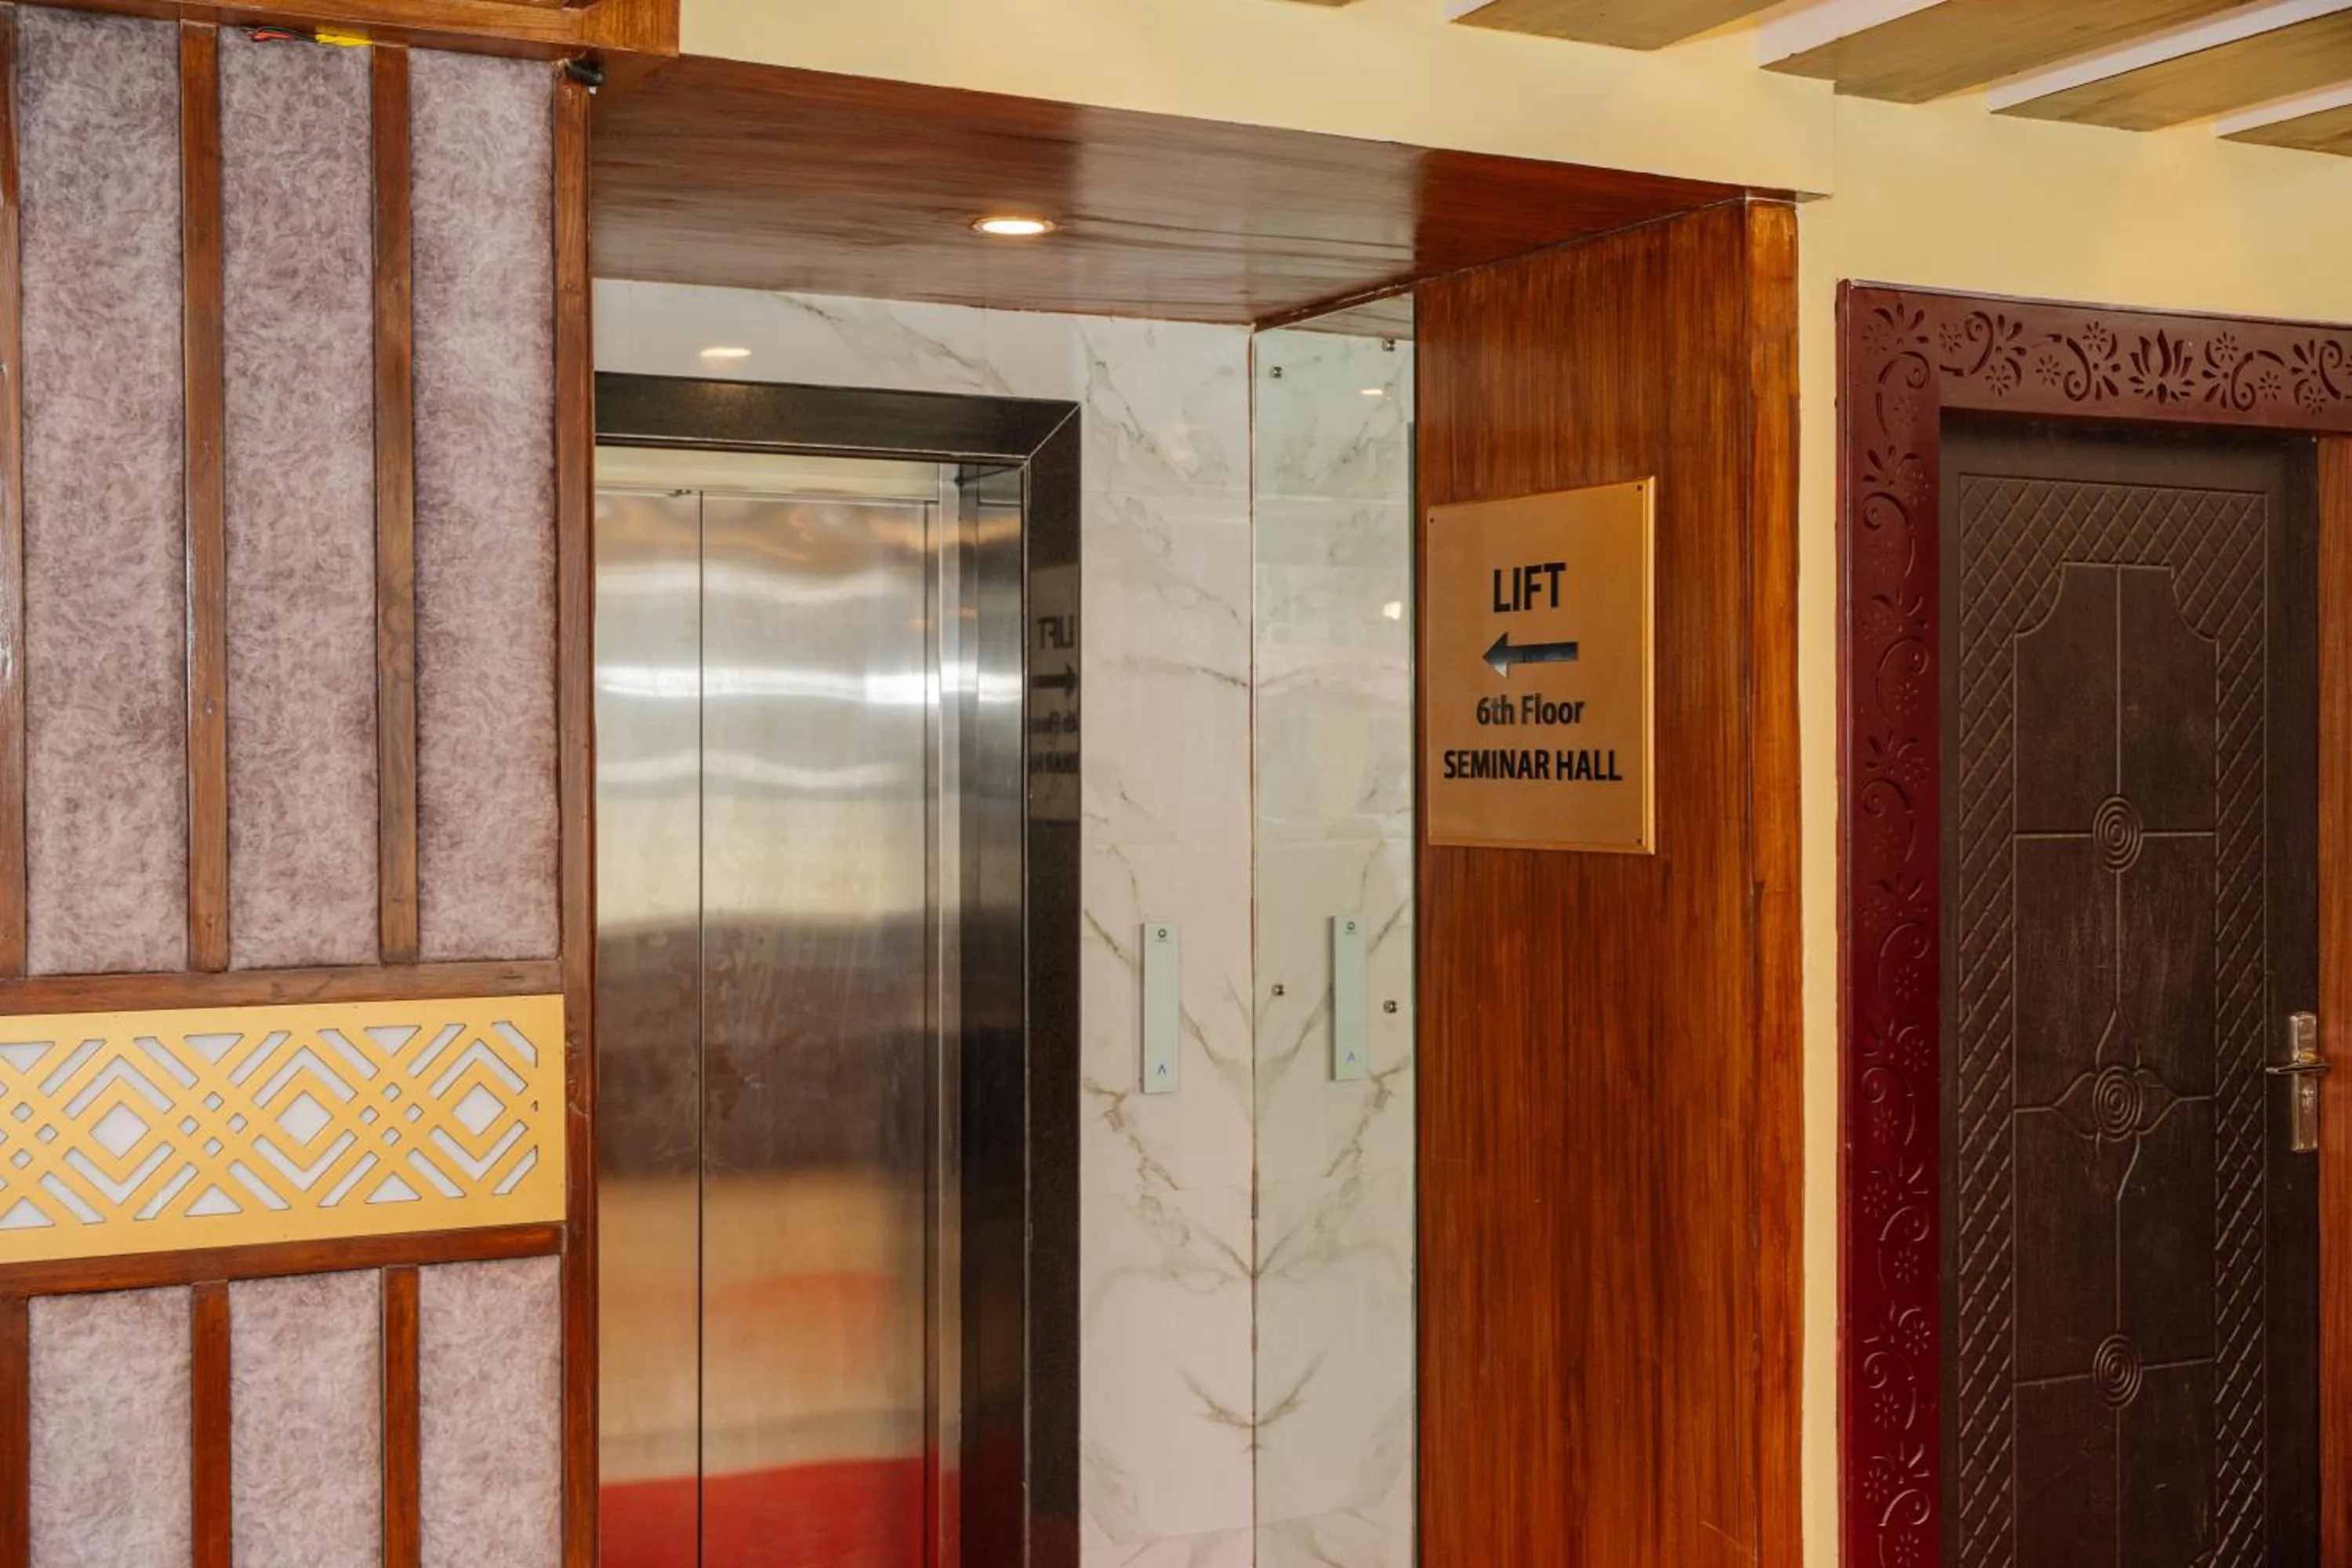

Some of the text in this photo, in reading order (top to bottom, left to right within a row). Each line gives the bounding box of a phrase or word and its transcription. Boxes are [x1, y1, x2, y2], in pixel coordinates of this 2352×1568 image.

[1493, 562, 1566, 612] LIFT
[1476, 693, 1585, 725] 6th Floor
[1443, 750, 1623, 781] SEMINAR HALL
